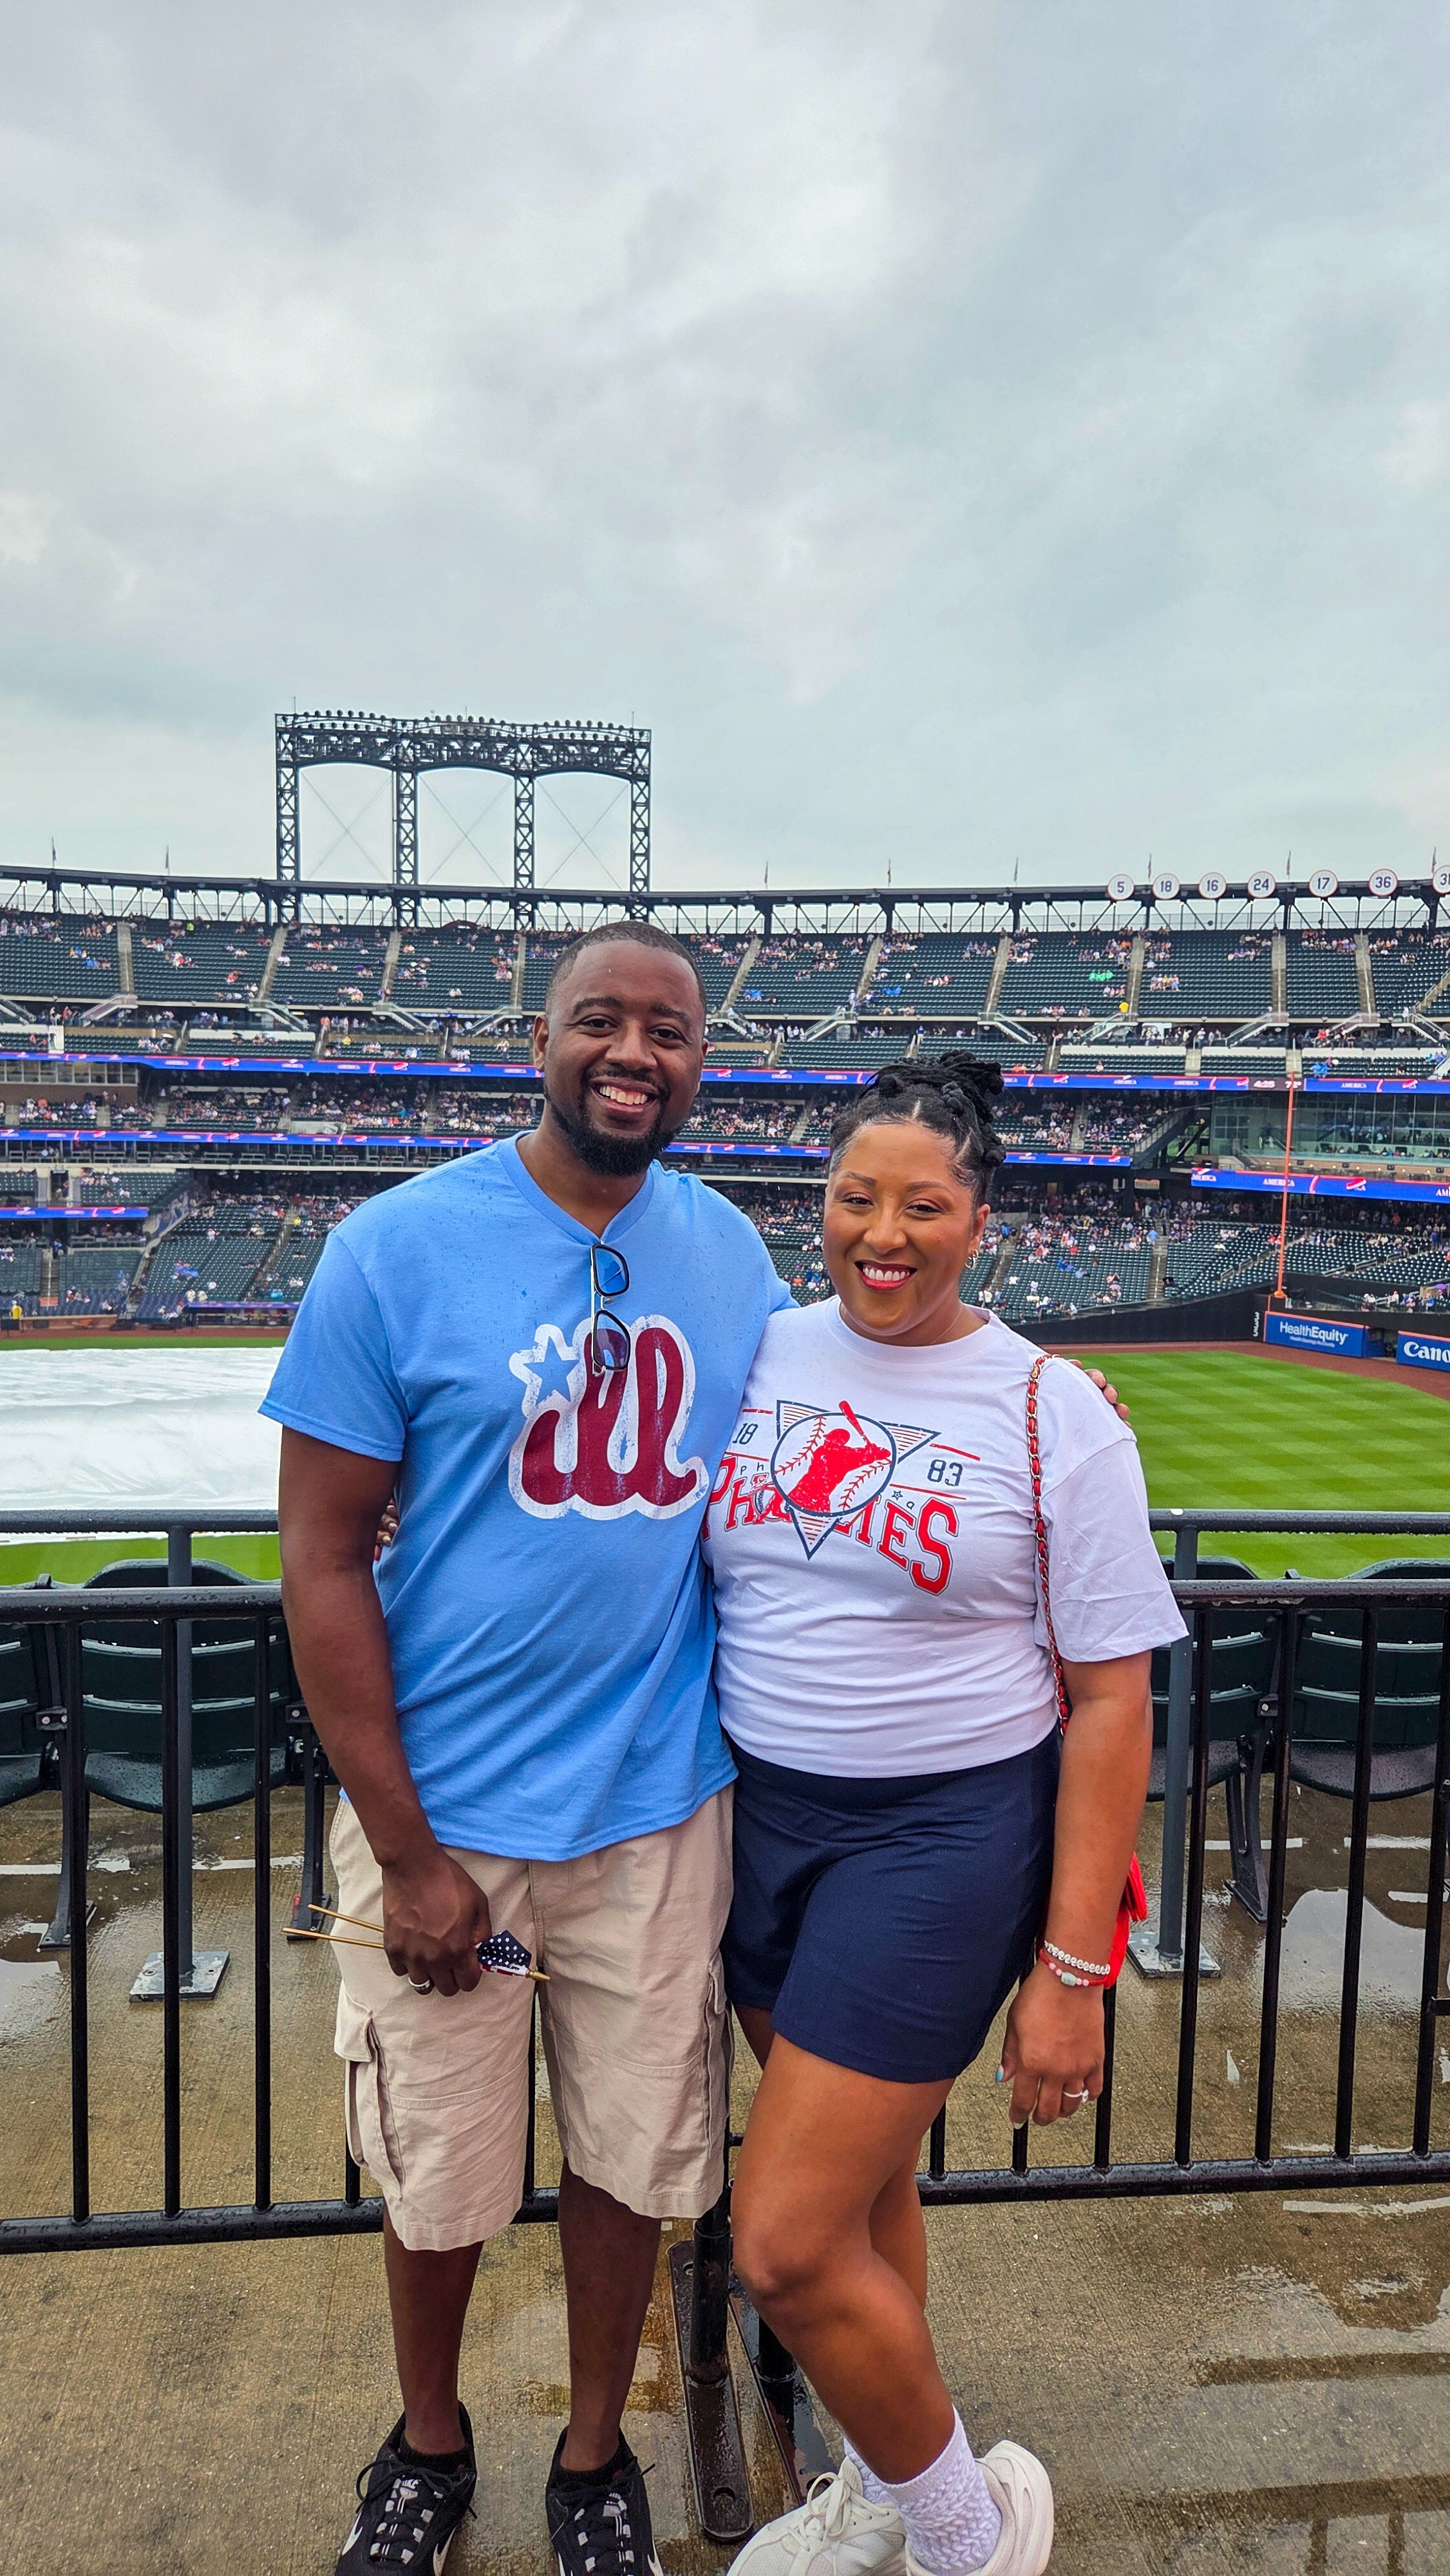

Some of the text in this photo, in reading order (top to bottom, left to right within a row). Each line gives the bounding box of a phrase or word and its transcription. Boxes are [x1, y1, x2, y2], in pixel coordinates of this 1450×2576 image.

[1117, 881, 1125, 893] 5
[1160, 880, 1172, 893] 18
[1207, 880, 1219, 892] 16
[1253, 878, 1269, 891] 24
[1317, 877, 1330, 889] 17
[1375, 876, 1391, 889] 36
[1279, 1321, 1347, 1345] HealthEquity
[732, 1423, 758, 1445] 18
[927, 1459, 964, 1486] 83
[701, 1455, 959, 1596] PHIES
